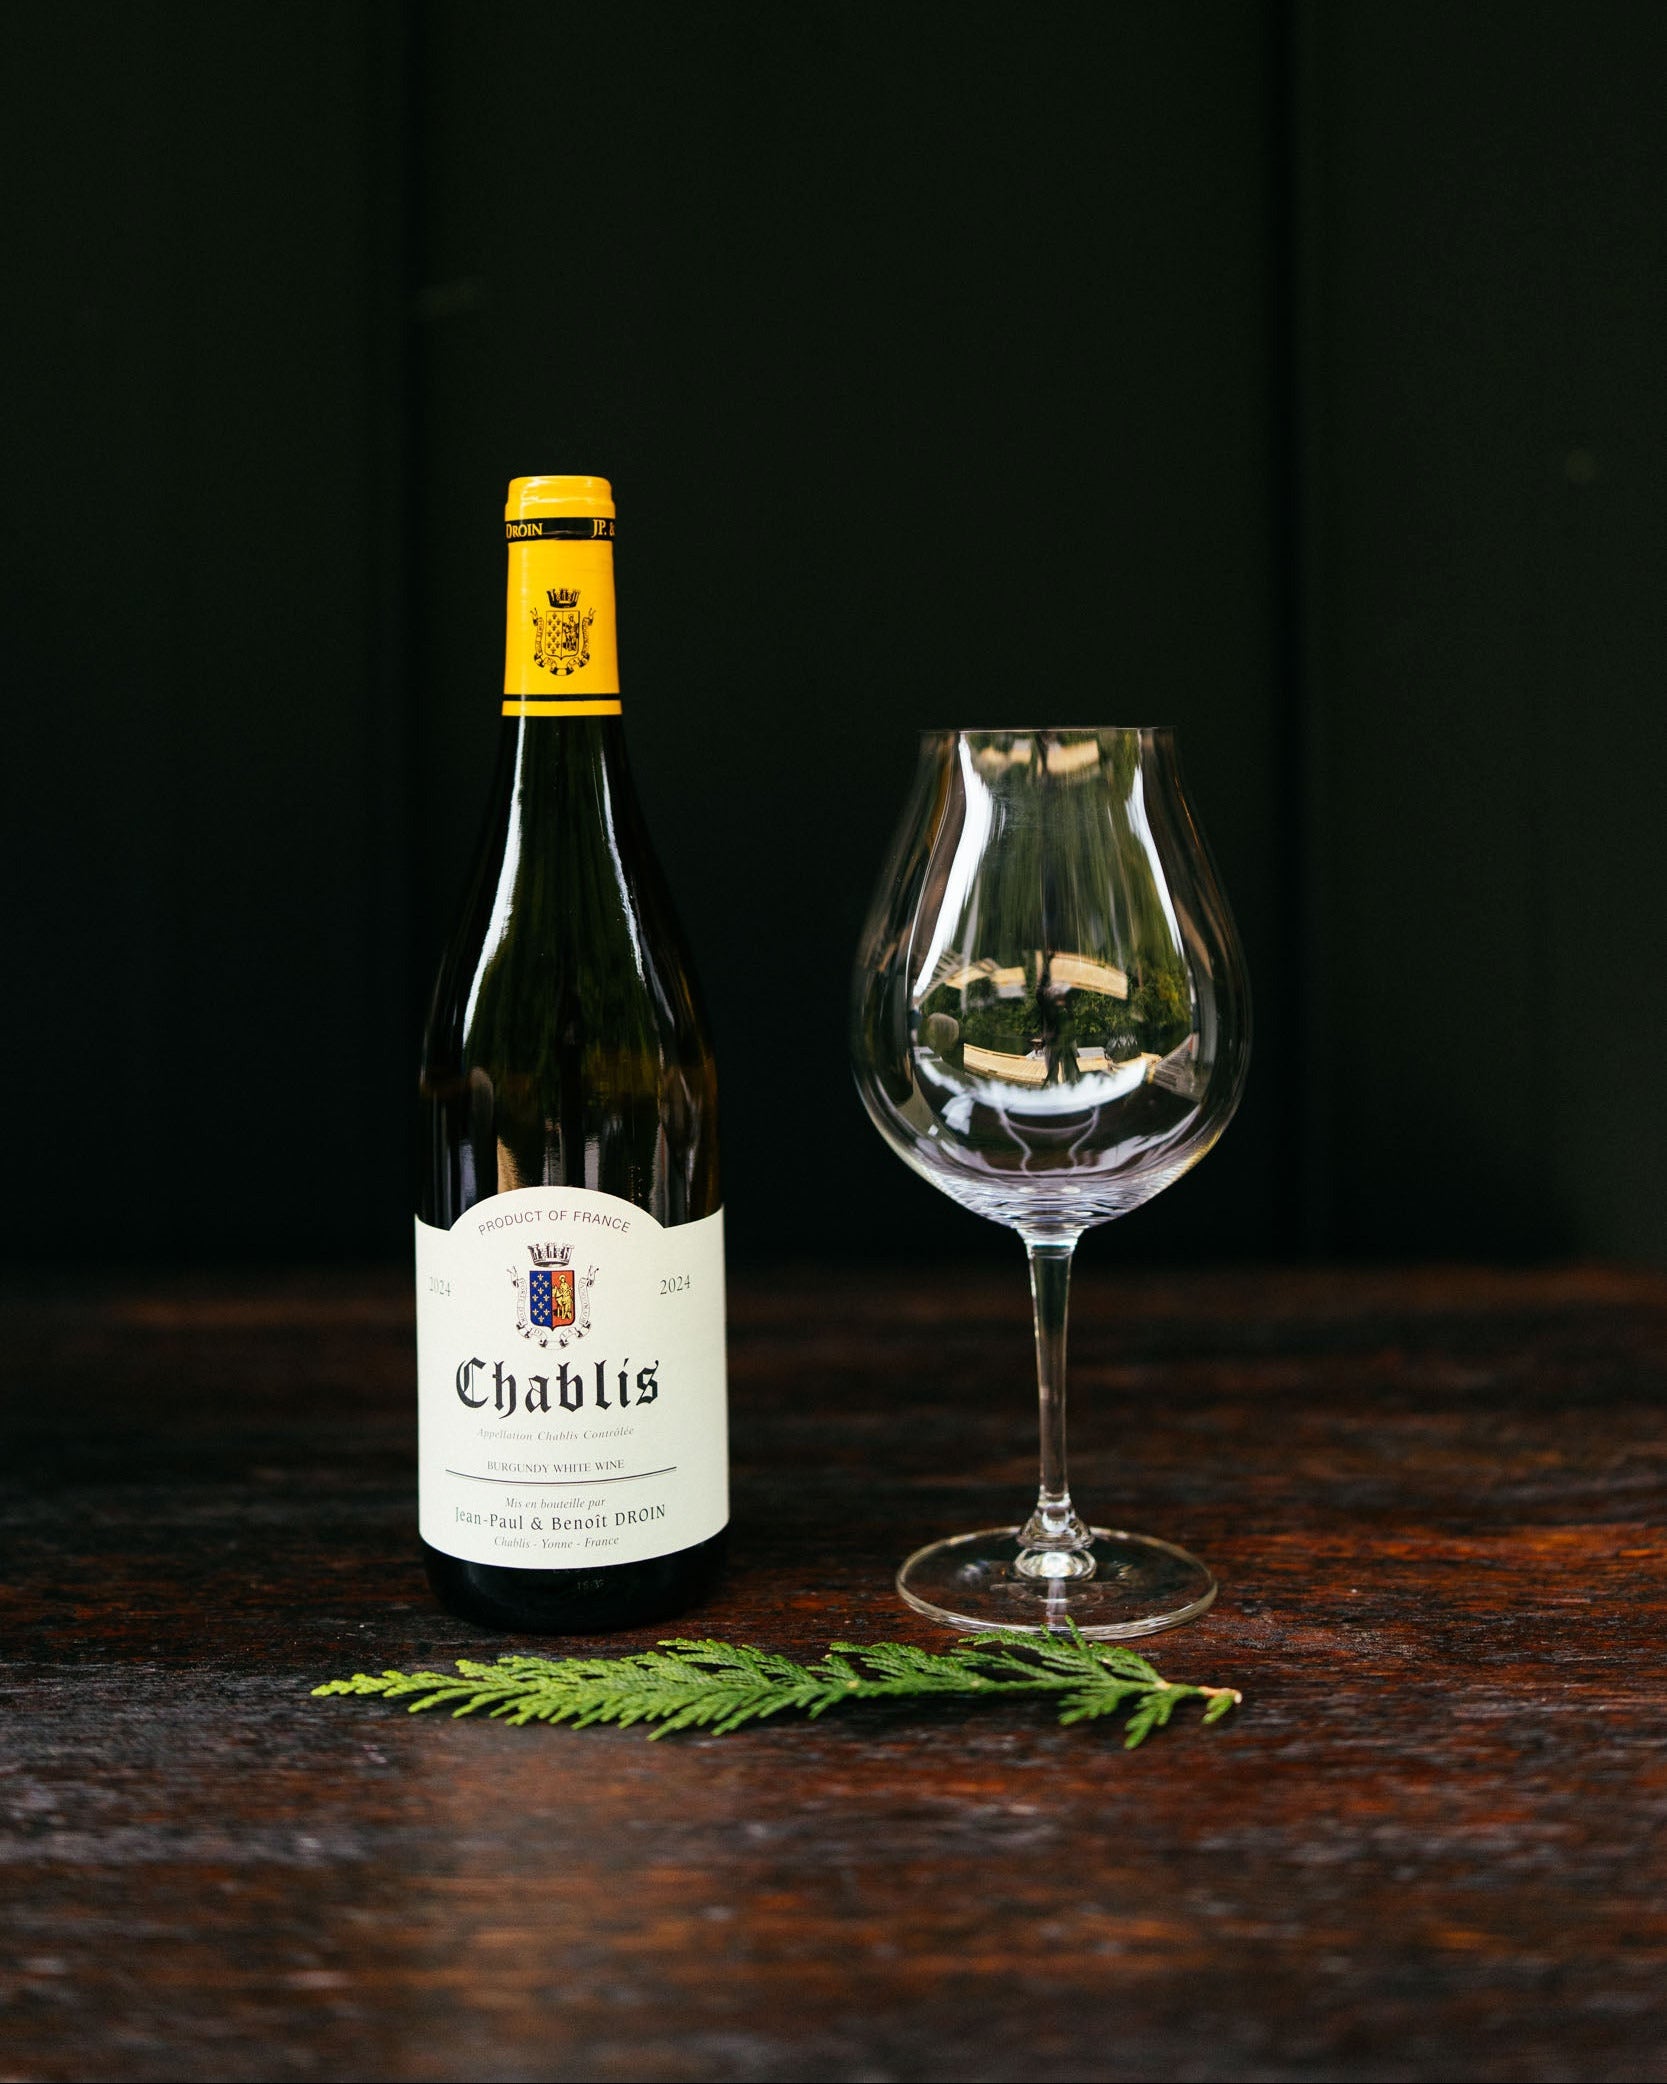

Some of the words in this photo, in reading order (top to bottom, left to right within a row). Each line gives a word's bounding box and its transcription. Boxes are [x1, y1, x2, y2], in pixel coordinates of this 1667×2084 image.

[591, 519, 607, 538] JP.
[478, 1210, 542, 1235] PRODUCT
[548, 1210, 567, 1221] OF
[573, 1211, 631, 1232] FRANCE
[428, 1275, 452, 1297] 2024
[659, 1274, 691, 1295] 2024
[455, 1357, 659, 1419] Chablis
[476, 1428, 533, 1441] Appellation
[537, 1430, 578, 1441] Chablis
[583, 1426, 634, 1440] Contrôlée
[487, 1460, 549, 1473] BURGUNDY
[553, 1463, 592, 1473] WHITE
[595, 1459, 625, 1471] WINE
[505, 1497, 522, 1508] Mis
[525, 1501, 537, 1509] en
[540, 1498, 585, 1509] bouteille
[587, 1498, 605, 1511] par
[455, 1506, 523, 1530] Jean-Paul
[530, 1516, 543, 1531] &
[552, 1514, 607, 1530] Benoît
[615, 1504, 665, 1526] DROIN
[494, 1535, 530, 1548] Chablis
[542, 1538, 573, 1549] Yonne
[584, 1537, 619, 1548] France
